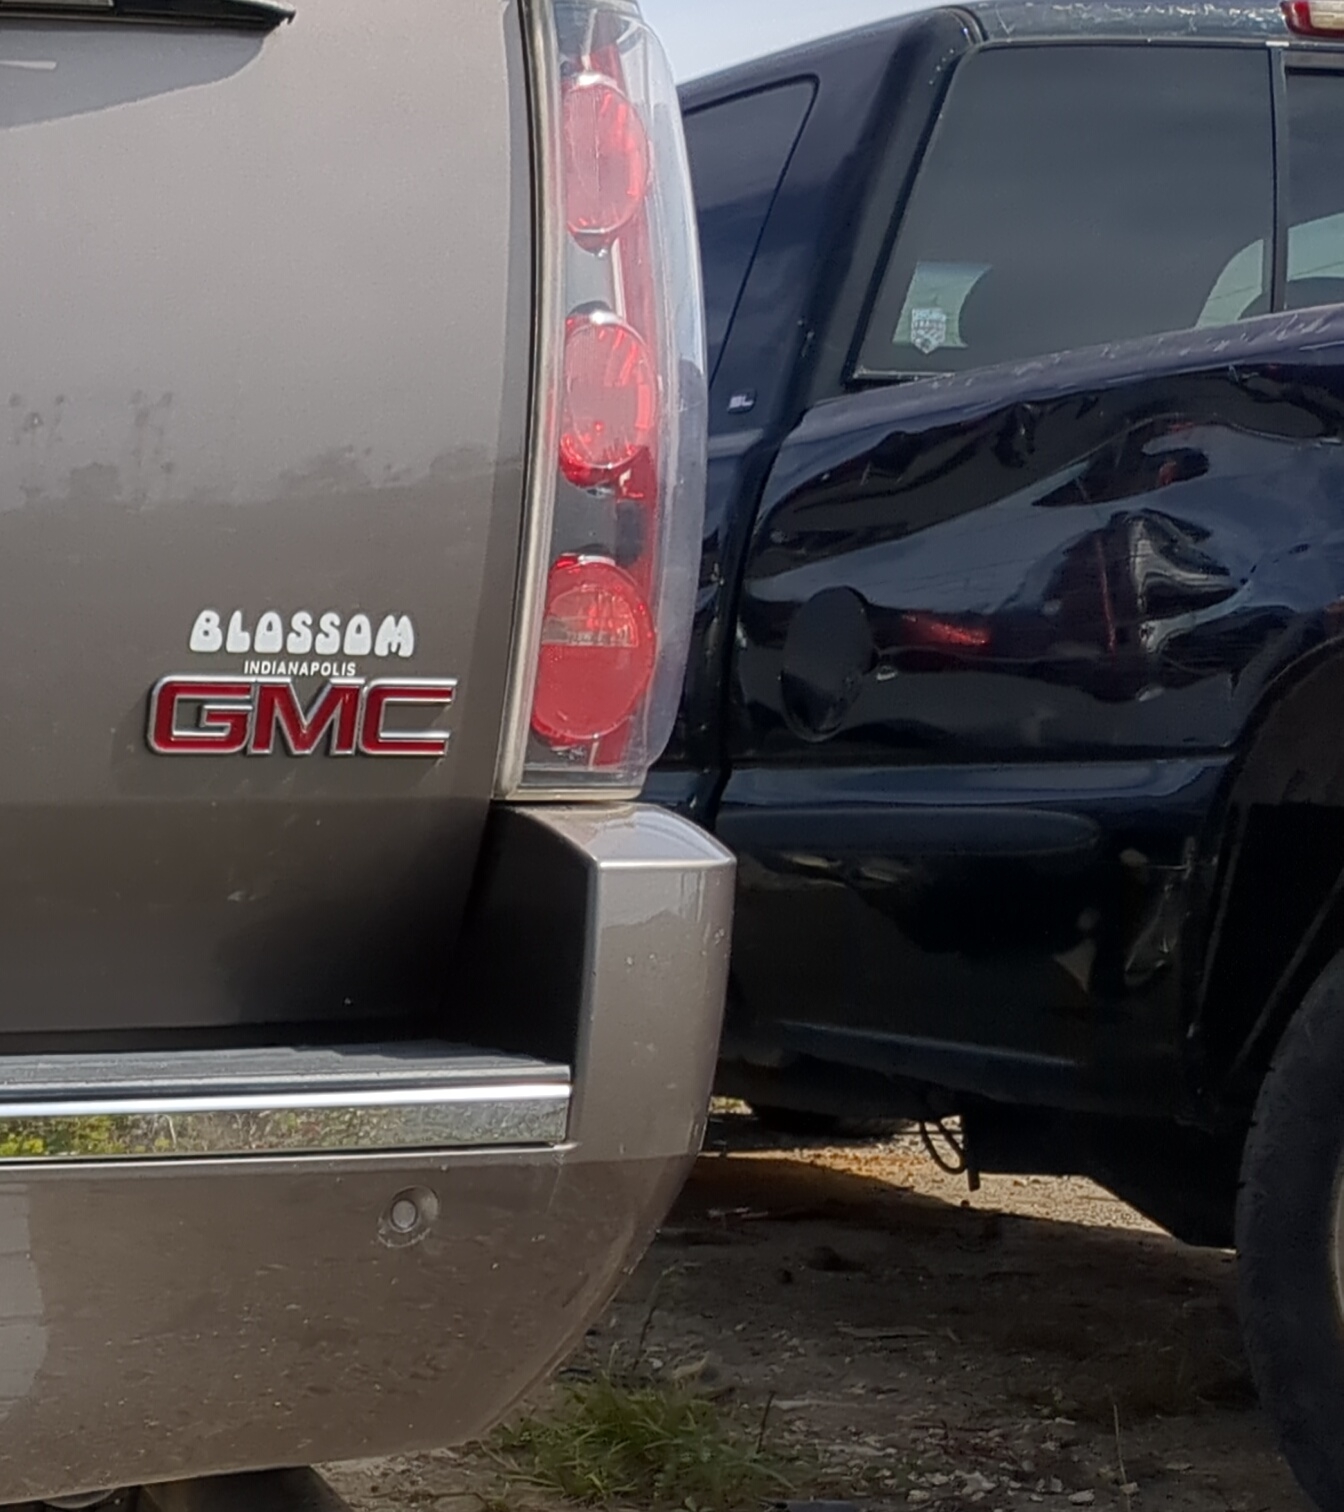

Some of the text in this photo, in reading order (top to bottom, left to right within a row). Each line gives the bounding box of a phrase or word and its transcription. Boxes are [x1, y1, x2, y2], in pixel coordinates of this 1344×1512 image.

[189, 609, 415, 658] BLOSSOM
[243, 660, 357, 677] INDIANAPOLIS
[147, 675, 459, 756] GMC
